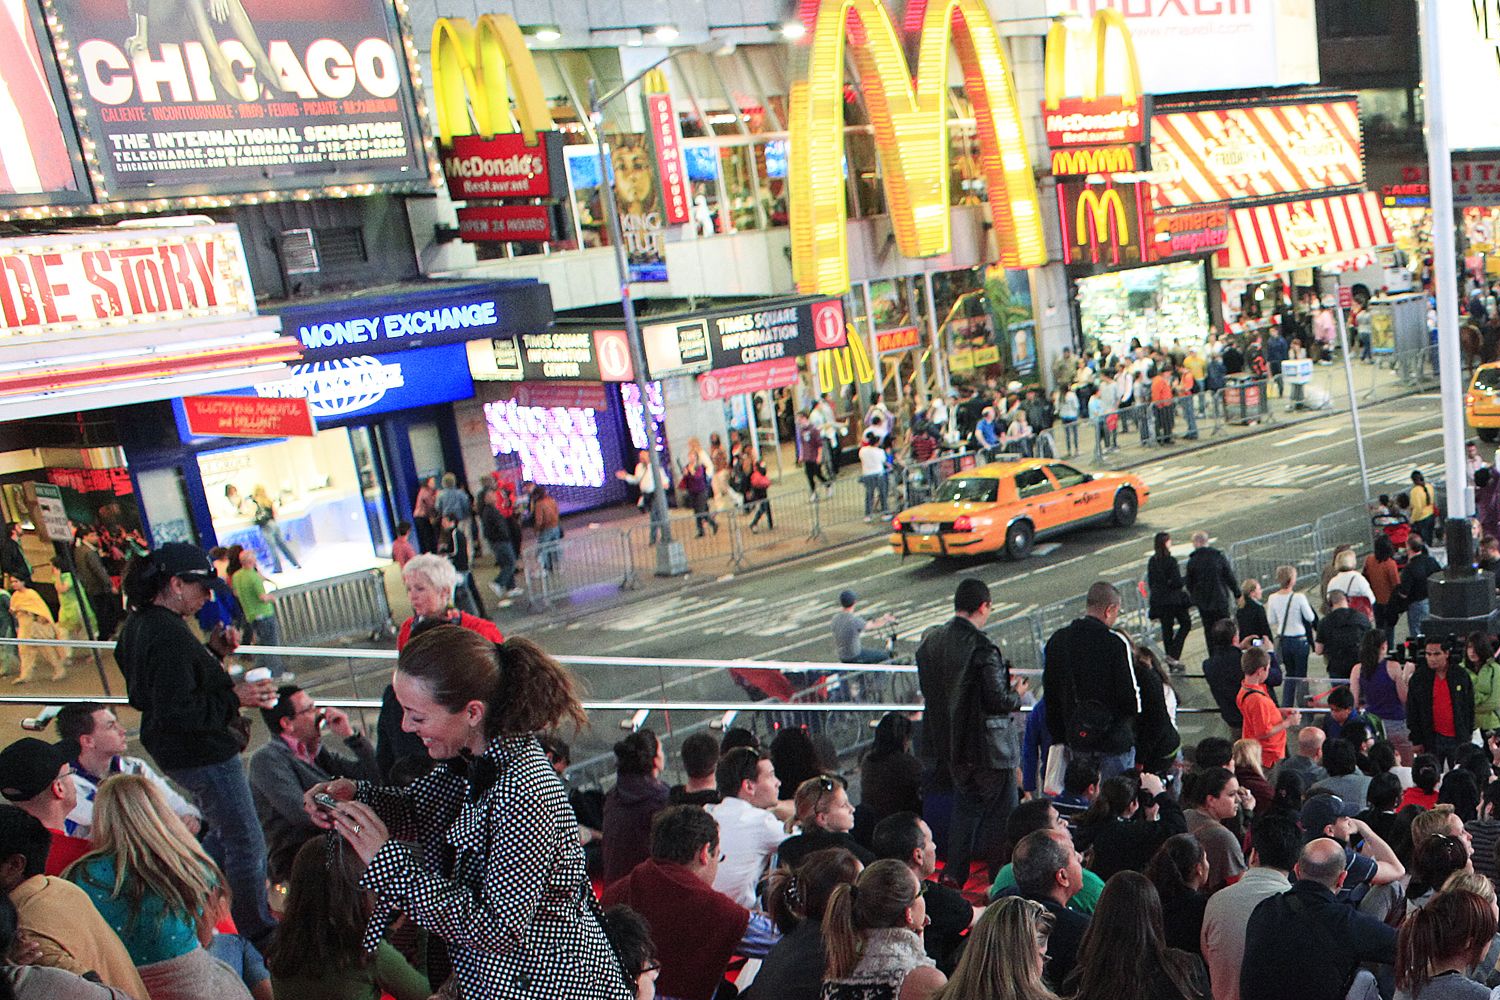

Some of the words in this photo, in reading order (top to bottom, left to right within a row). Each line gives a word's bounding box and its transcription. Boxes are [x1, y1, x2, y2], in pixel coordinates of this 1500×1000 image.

[77, 37, 400, 105] CHICAGO
[101, 106, 148, 122] CALIENTE
[656, 100, 673, 147] OPEN
[1046, 110, 1140, 132] McDonald's
[108, 133, 150, 150] THE
[151, 126, 302, 149] INTERNATIONAL
[444, 153, 543, 177] McDonald's
[463, 178, 530, 193] Restaurant
[667, 161, 686, 218] HOURS
[0, 252, 78, 328] DE
[81, 241, 218, 318] STORY
[299, 316, 379, 349] MONEY
[384, 301, 498, 339] EXCHANGE
[716, 314, 755, 335] TIMES
[753, 307, 799, 330] SQUARE
[720, 323, 799, 352] INFORMATION
[741, 332, 785, 364] CENTER
